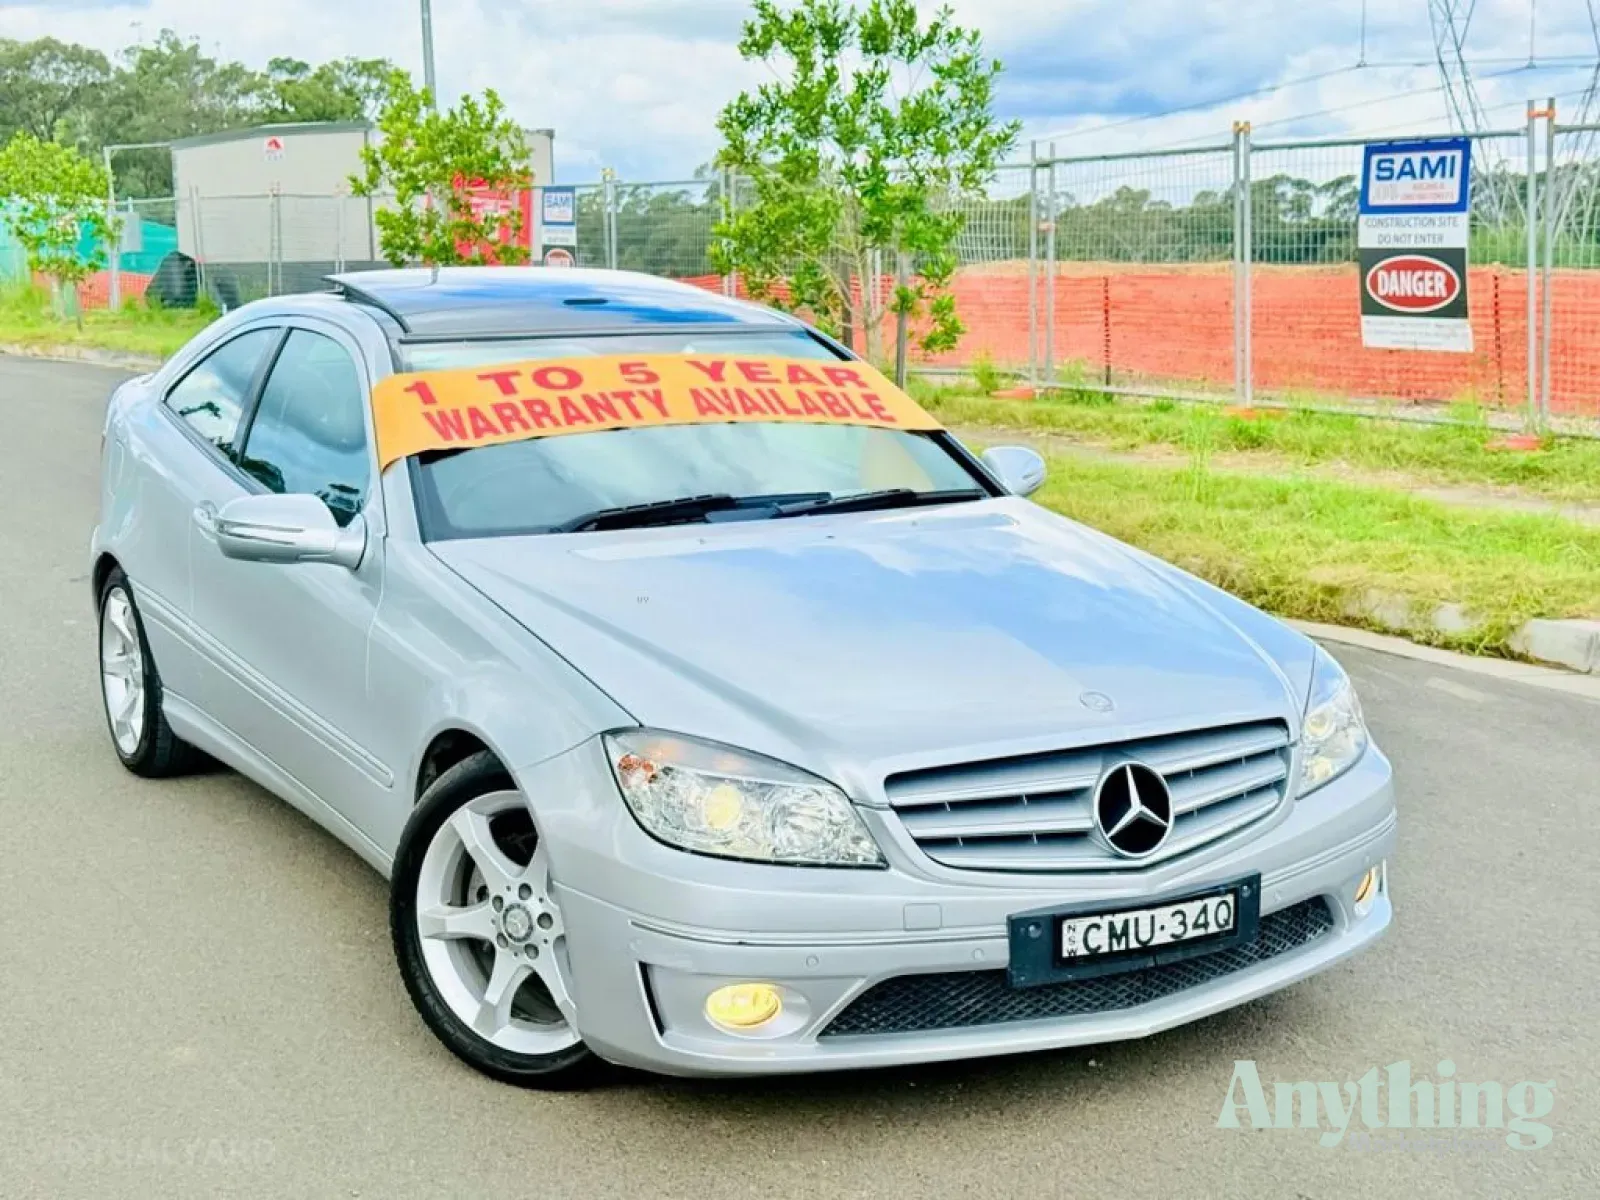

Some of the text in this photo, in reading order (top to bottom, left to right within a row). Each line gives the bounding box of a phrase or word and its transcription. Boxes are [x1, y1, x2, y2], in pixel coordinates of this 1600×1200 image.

[1375, 154, 1456, 181] SAMI
[1365, 215, 1459, 228] CONSTRUCTION SITE
[1377, 232, 1444, 245] DO NOT ENTER
[1377, 269, 1447, 298] DANGER
[404, 360, 871, 405] 1 TO 5 YEAR
[421, 387, 897, 442] WARRANTY AVAILABLE
